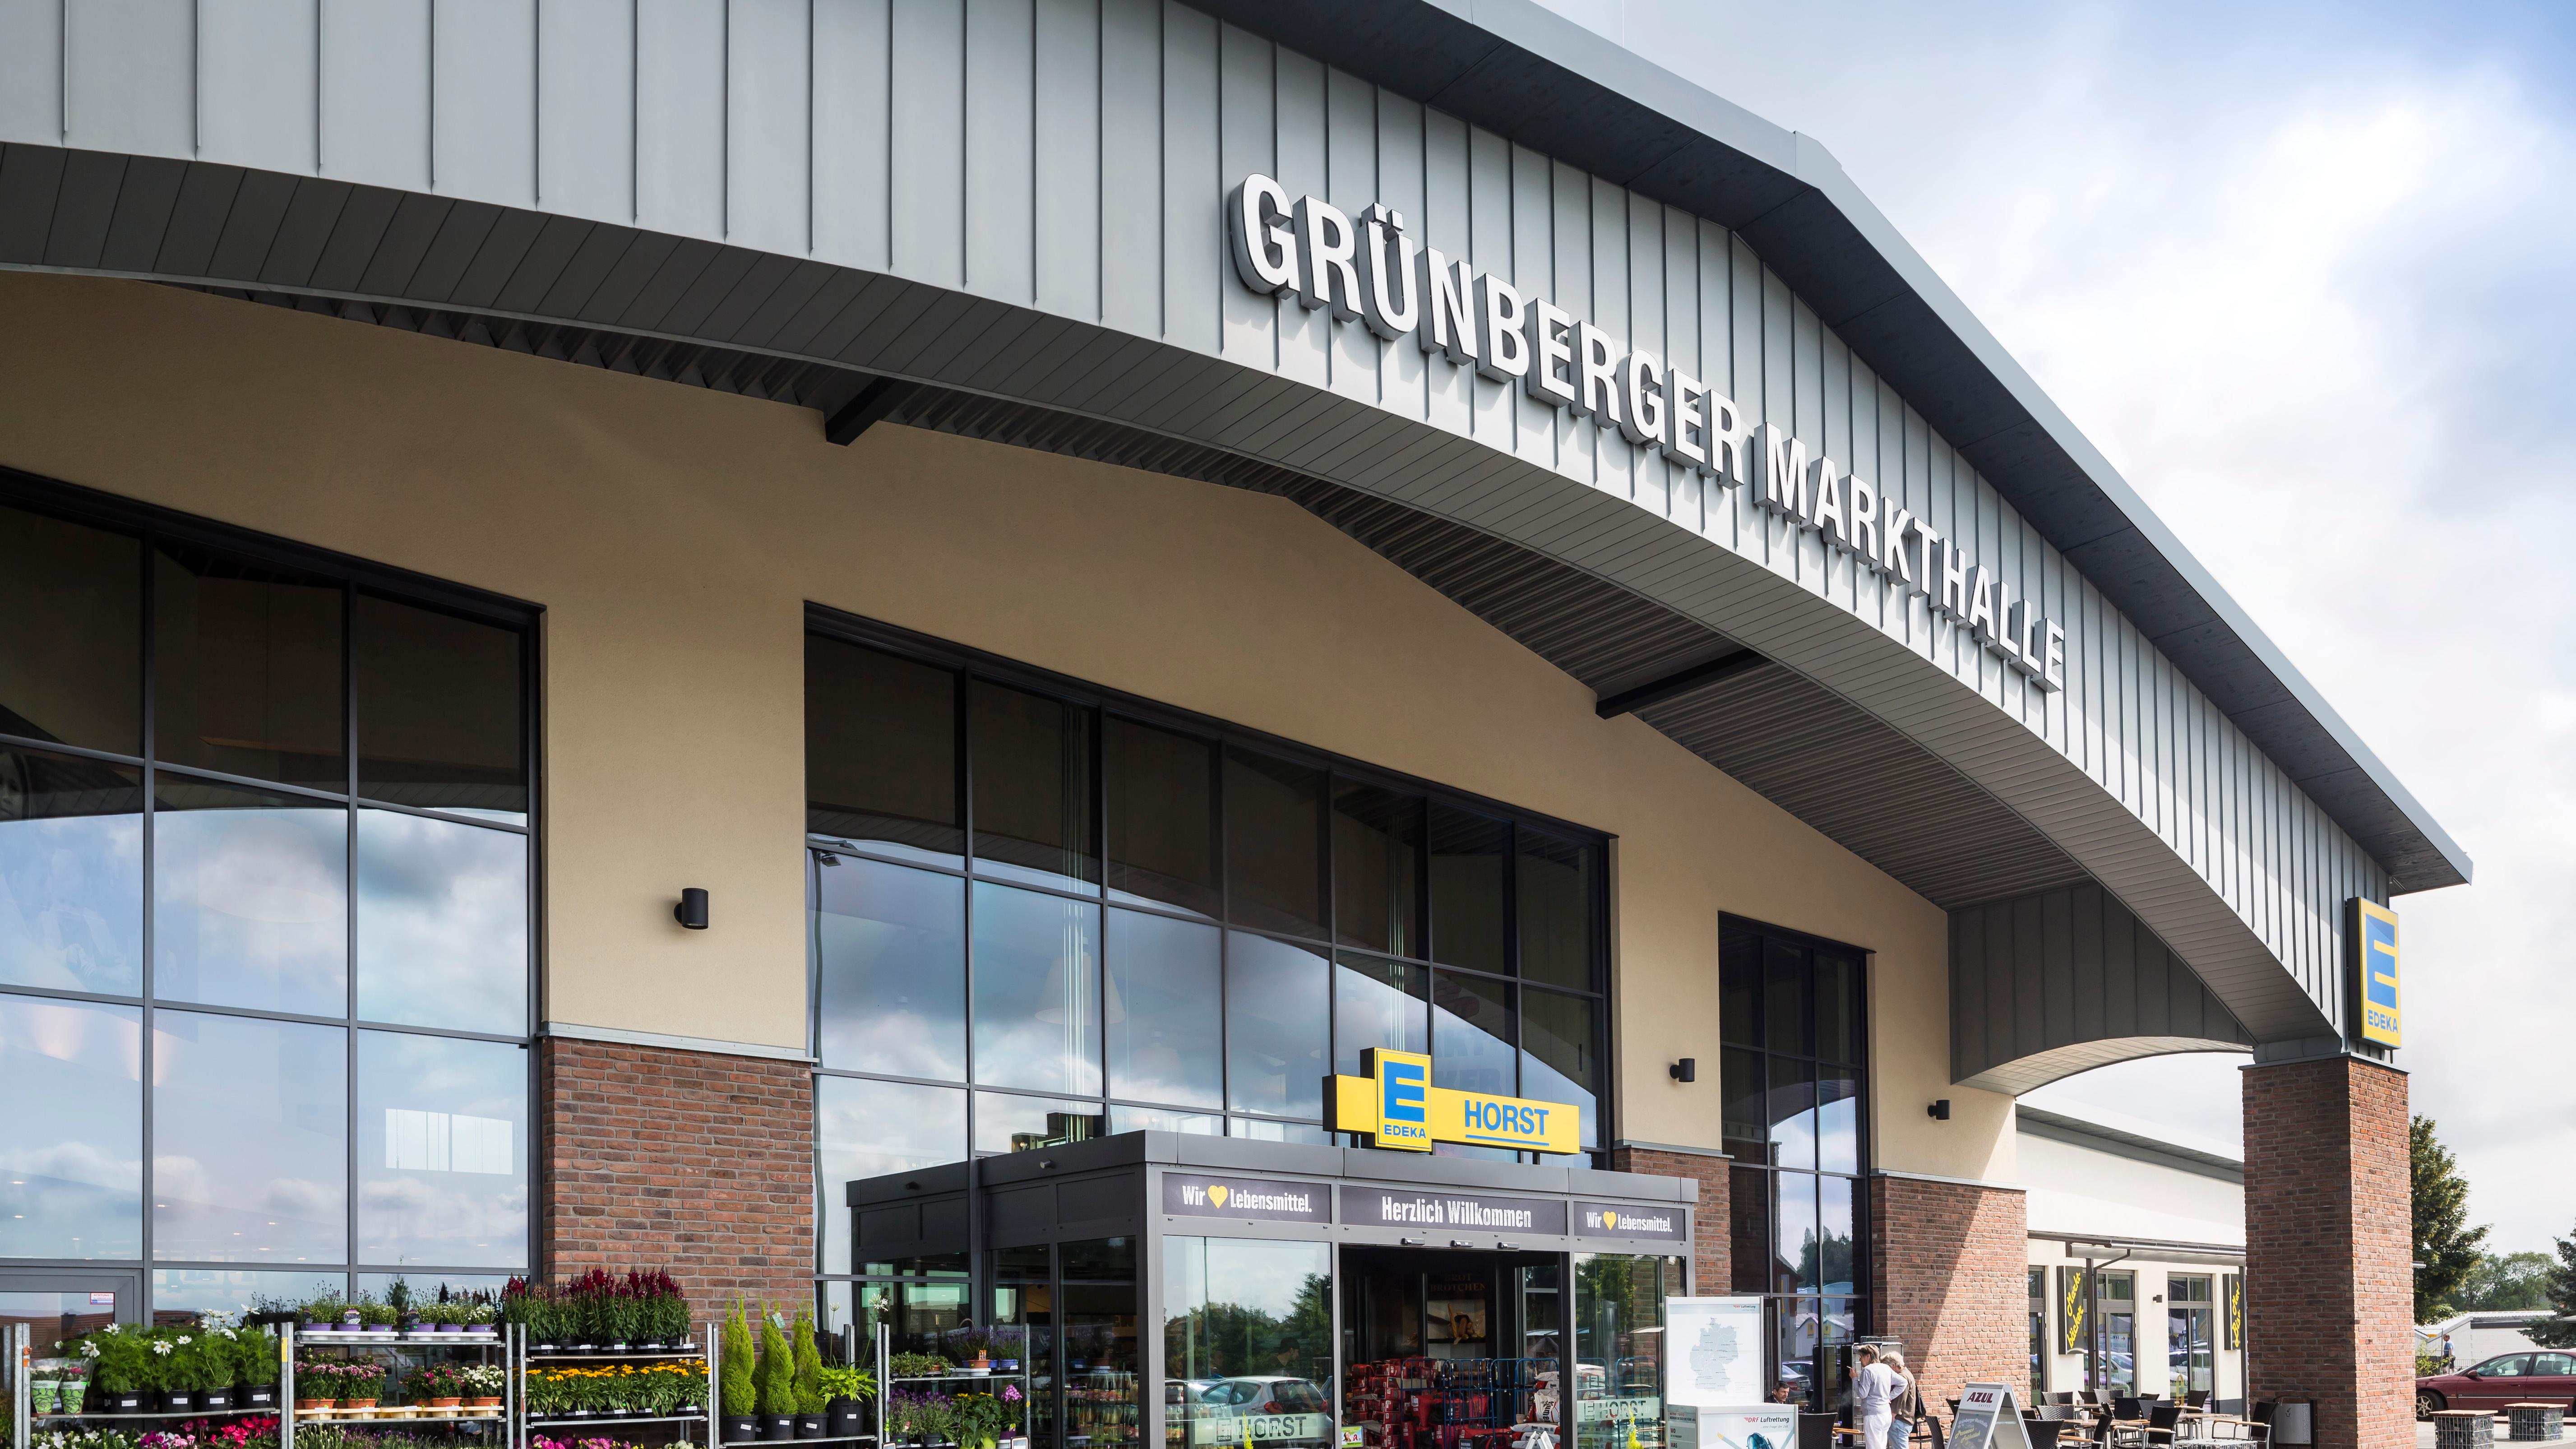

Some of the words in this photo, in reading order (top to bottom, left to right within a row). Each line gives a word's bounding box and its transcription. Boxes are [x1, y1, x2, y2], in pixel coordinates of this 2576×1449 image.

[1241, 172, 1744, 487] GRÜNBERGER
[1760, 421, 2065, 692] MARKTHALLE
[2368, 1009, 2399, 1034] EDEKA
[1465, 1100, 1549, 1136] HORST
[1384, 1124, 1427, 1139] EDEKA
[1182, 1185, 1205, 1206] Wir
[1230, 1188, 1312, 1213] Lebensmittel.
[1382, 1196, 1443, 1223] Herzlich
[1447, 1200, 1531, 1228] Willkommen
[1586, 1211, 1602, 1228] Wir
[1618, 1214, 1673, 1233] Lebensmittel.
[2067, 1304, 2084, 1349] bäcker
[1600, 1400, 1646, 1419] HORST
[1966, 1391, 1994, 1403] AZUL
[1239, 1416, 1307, 1439] HORST
